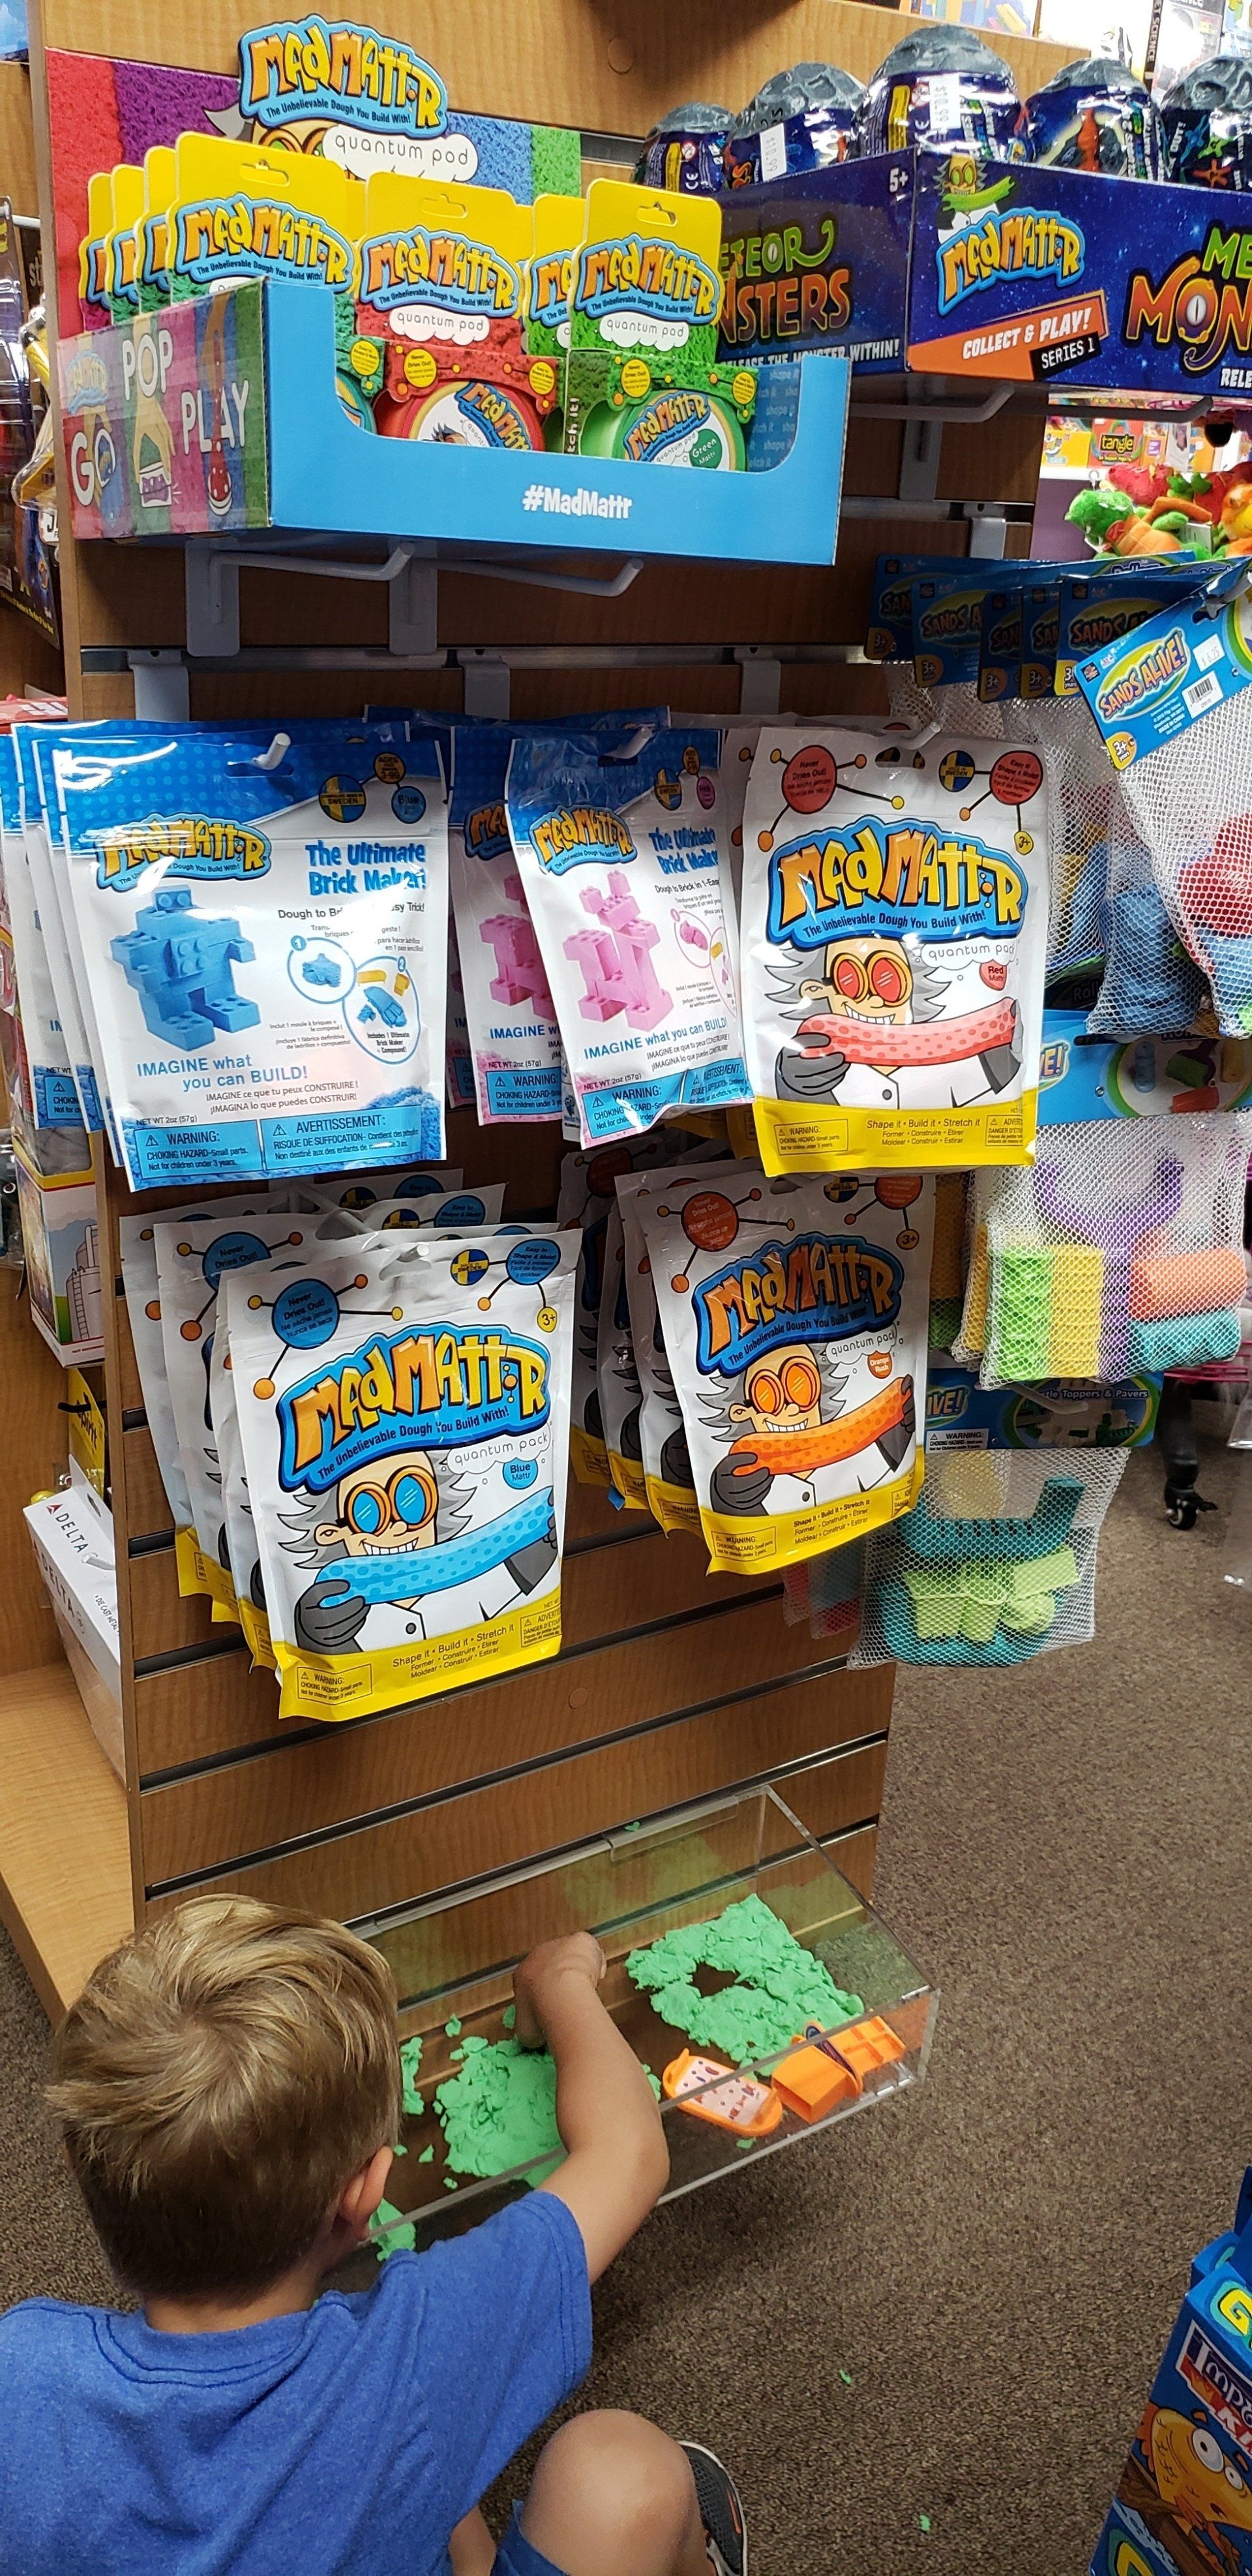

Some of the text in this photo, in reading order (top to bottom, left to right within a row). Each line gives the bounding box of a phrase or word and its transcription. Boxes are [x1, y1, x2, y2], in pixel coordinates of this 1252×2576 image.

[1148, 18, 1159, 62] SCIENCE
[267, 98, 411, 124] The Unbelievable Dough You Build With!
[335, 134, 468, 166] quantum pod
[889, 168, 908, 193] 5+
[719, 220, 835, 280] ETEOR
[719, 268, 850, 344] NSTERS
[397, 311, 484, 331] quantum pod
[607, 320, 683, 338] quantum pod
[963, 308, 1090, 359] COLLECT & PLAY!
[850, 338, 899, 362] WITHIN!
[1041, 340, 1095, 369] SERIES 1
[122, 329, 173, 400] POP
[181, 380, 249, 455] PLAY
[692, 439, 717, 458] Green
[1101, 436, 1133, 453] tangle
[71, 428, 115, 506] GO
[522, 485, 633, 518] #MadMattr
[922, 607, 967, 636] SANDS
[1100, 634, 1185, 717] SANDS ALIVE!
[1113, 741, 1127, 755] 3+
[398, 794, 419, 804] Blue
[305, 840, 426, 866] The Ultimate
[1019, 836, 1030, 848] 3+
[308, 869, 359, 896] Brick
[278, 908, 312, 920] Dough
[803, 910, 986, 938] The Unbelievable Dough You Build With!
[988, 966, 1004, 974] Red
[490, 1025, 545, 1040] IMAGINE
[584, 1017, 728, 1060] IMAGINE what you can BUILD!
[137, 1054, 253, 1077] IMAGINE what
[183, 1066, 308, 1092] you can BUILD!
[513, 1074, 558, 1086] WARNING:
[206, 1091, 242, 1101] IMAGINE
[254, 1089, 270, 1099] que
[282, 1086, 303, 1096] peux
[304, 1082, 353, 1092] CONSTRUIRE
[612, 1087, 661, 1101] WARNING:
[210, 1103, 248, 1115] ¡IMAGINA
[260, 1101, 277, 1111] que
[278, 1098, 308, 1109] puedes
[309, 1093, 357, 1104] CONSTRUIR!
[179, 1115, 198, 1123] (57g)
[867, 1120, 894, 1130] Shape
[908, 1119, 928, 1128] Build
[943, 1118, 974, 1127] Stretch
[975, 1118, 980, 1126] it
[166, 1131, 220, 1145] WARNING:
[789, 1126, 821, 1135] WARNING:
[147, 1150, 179, 1161] CHOKING
[902, 1235, 916, 1244] 3+
[219, 1245, 245, 1257] Never
[284, 1298, 325, 1320] Dries Out!
[288, 1292, 312, 1306] Never
[542, 1313, 556, 1325] 3+
[728, 1308, 869, 1366] The Unbelievable Dough You Build With!
[869, 1358, 889, 1367] Orange
[875, 1364, 889, 1372] Rush
[1062, 1390, 1100, 1400] Toppers
[318, 1407, 510, 1480] The Unbelievable Dough You Build With!
[455, 1432, 548, 1466] quantum pack
[510, 1463, 531, 1473] Blue
[511, 1471, 531, 1481] Mattr
[55, 1512, 89, 1553] DELTA
[42, 1552, 75, 1618] DELTA
[96, 1598, 104, 1607] DIE
[100, 1606, 112, 1619] CAST
[393, 1653, 421, 1668] Shape
[425, 1649, 430, 1658] it
[438, 1641, 460, 1655] Build
[463, 1638, 469, 1647] it
[476, 1627, 507, 1642] Stretch
[509, 1624, 514, 1632] it
[411, 1659, 434, 1671] Former
[442, 1647, 476, 1663] Construire
[411, 1647, 499, 1679] Moldear Construir Estirar
[314, 1673, 345, 1685] WARNING:
